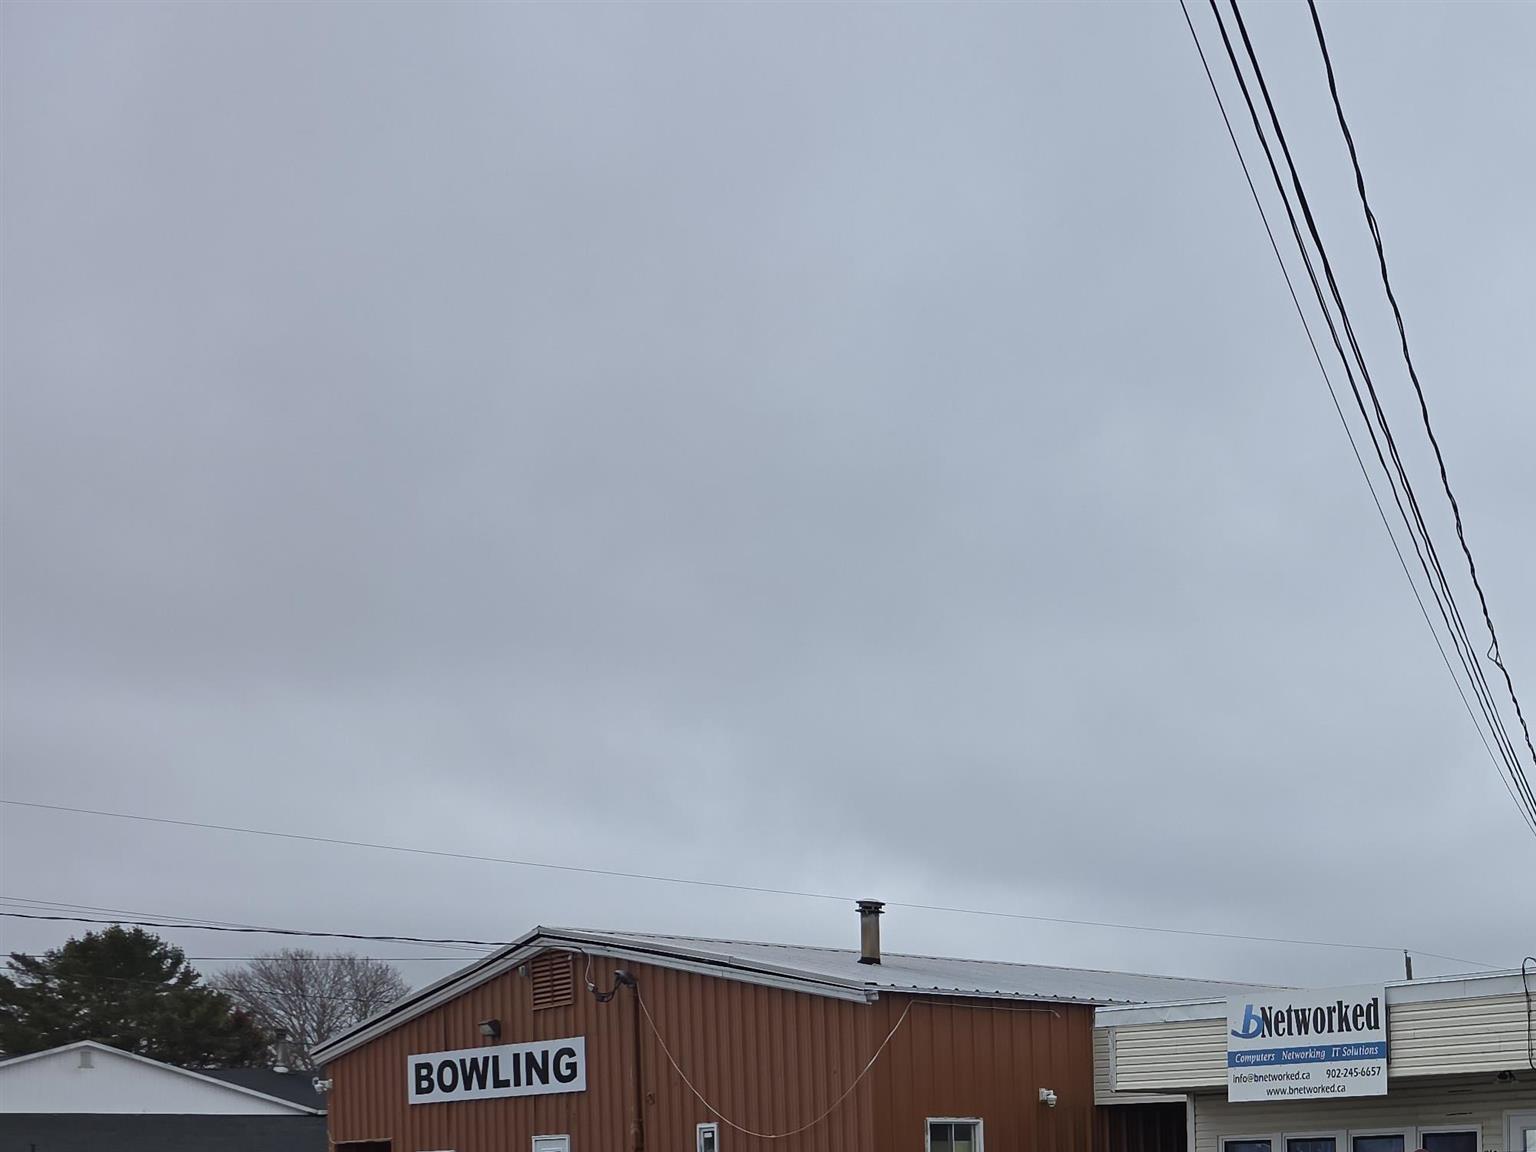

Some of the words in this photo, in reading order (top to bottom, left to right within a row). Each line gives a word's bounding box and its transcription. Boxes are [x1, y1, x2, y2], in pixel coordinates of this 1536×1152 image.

[1235, 1051, 1275, 1064] Computers
[1281, 1049, 1326, 1061] Networking
[1331, 1047, 1341, 1058] IT
[1342, 1045, 1379, 1057] Solutions
[414, 1047, 578, 1096] BOWLING
[1232, 1070, 1311, 1084] info@bnetworked.ca
[1326, 1066, 1382, 1079] 902-245-6657
[1266, 1083, 1346, 1096] www.bnetworked.ca
